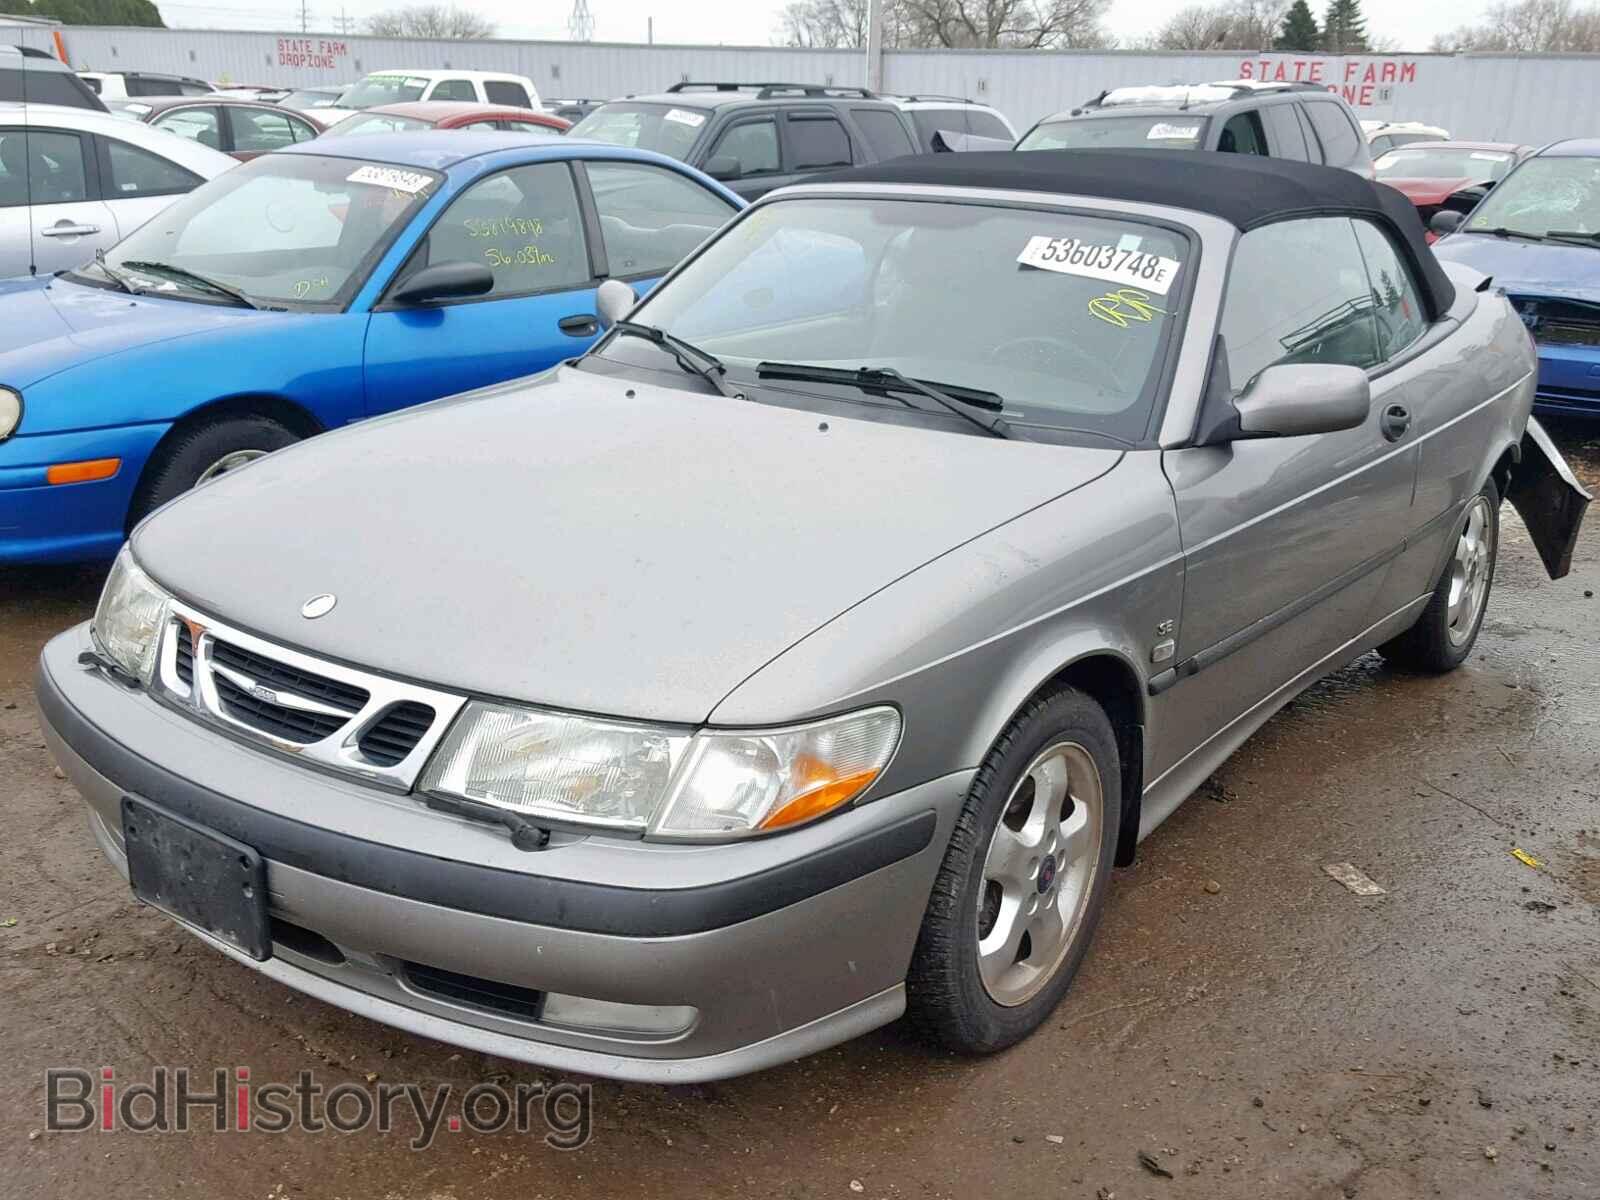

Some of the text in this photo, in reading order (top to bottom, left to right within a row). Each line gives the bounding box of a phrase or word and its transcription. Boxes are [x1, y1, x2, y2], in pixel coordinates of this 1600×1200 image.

[278, 39, 347, 55] STATE FARM
[279, 53, 336, 69] DROPZONE
[1239, 60, 1417, 83] STATE FARM
[1158, 619, 1174, 636] SE
